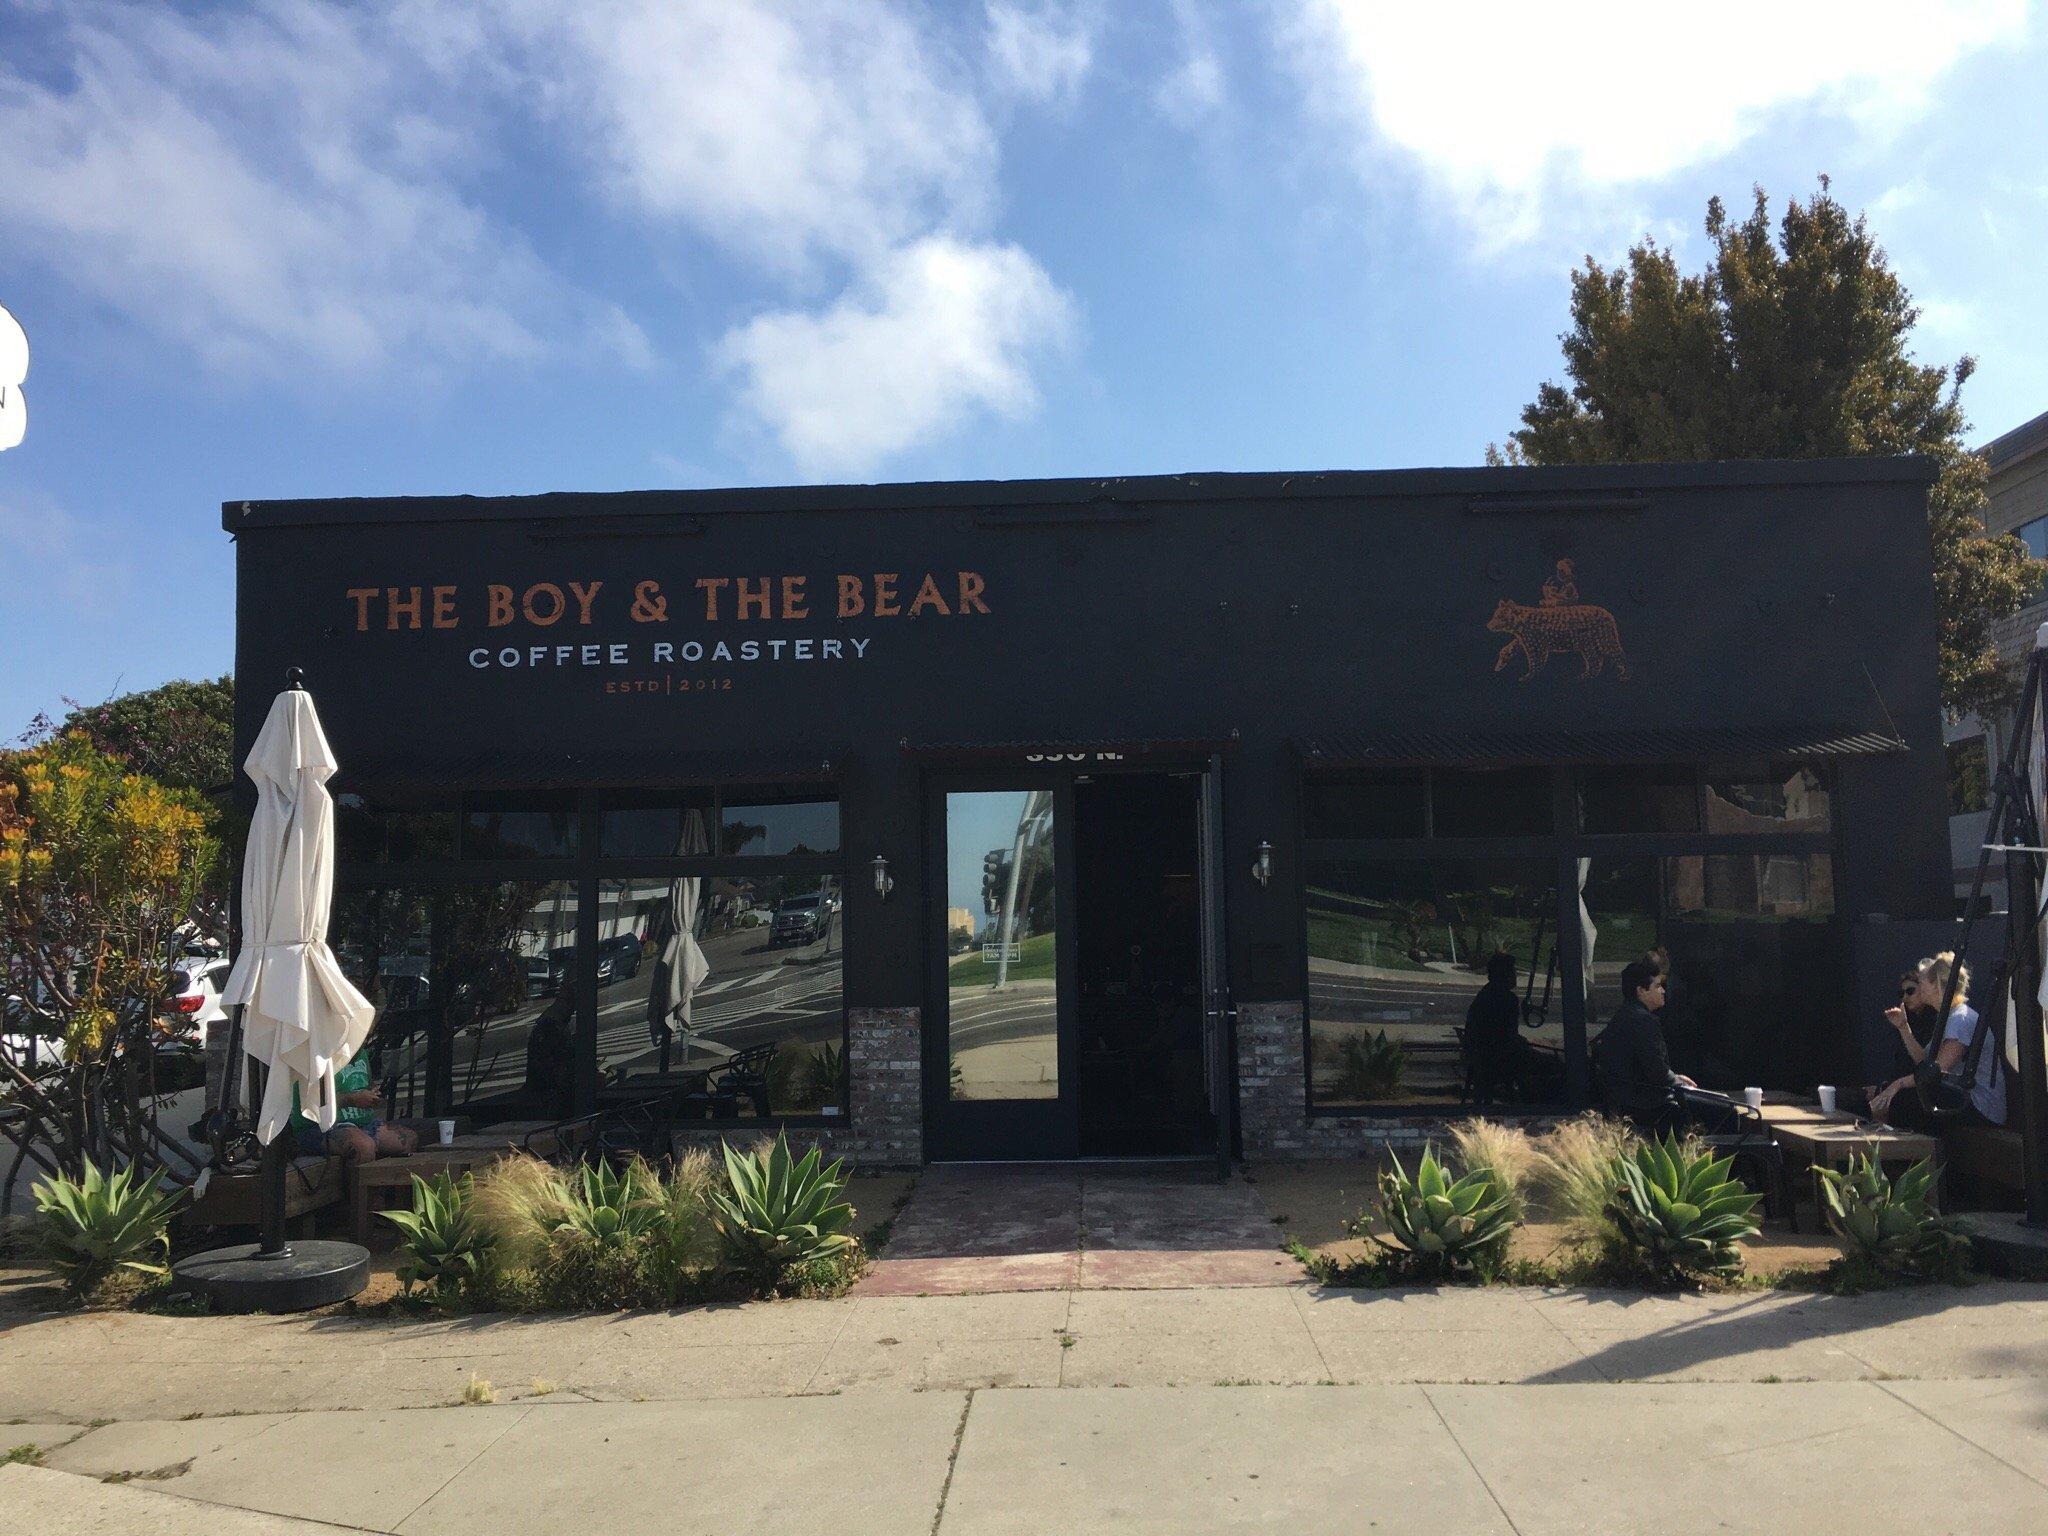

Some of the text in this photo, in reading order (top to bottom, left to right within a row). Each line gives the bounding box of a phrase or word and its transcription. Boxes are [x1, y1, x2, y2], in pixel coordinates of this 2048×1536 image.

[347, 572, 992, 632] THE BOY & THE BEAR
[469, 639, 871, 668] COFFEE ROASTERY
[606, 679, 732, 693] ESTD 2012
